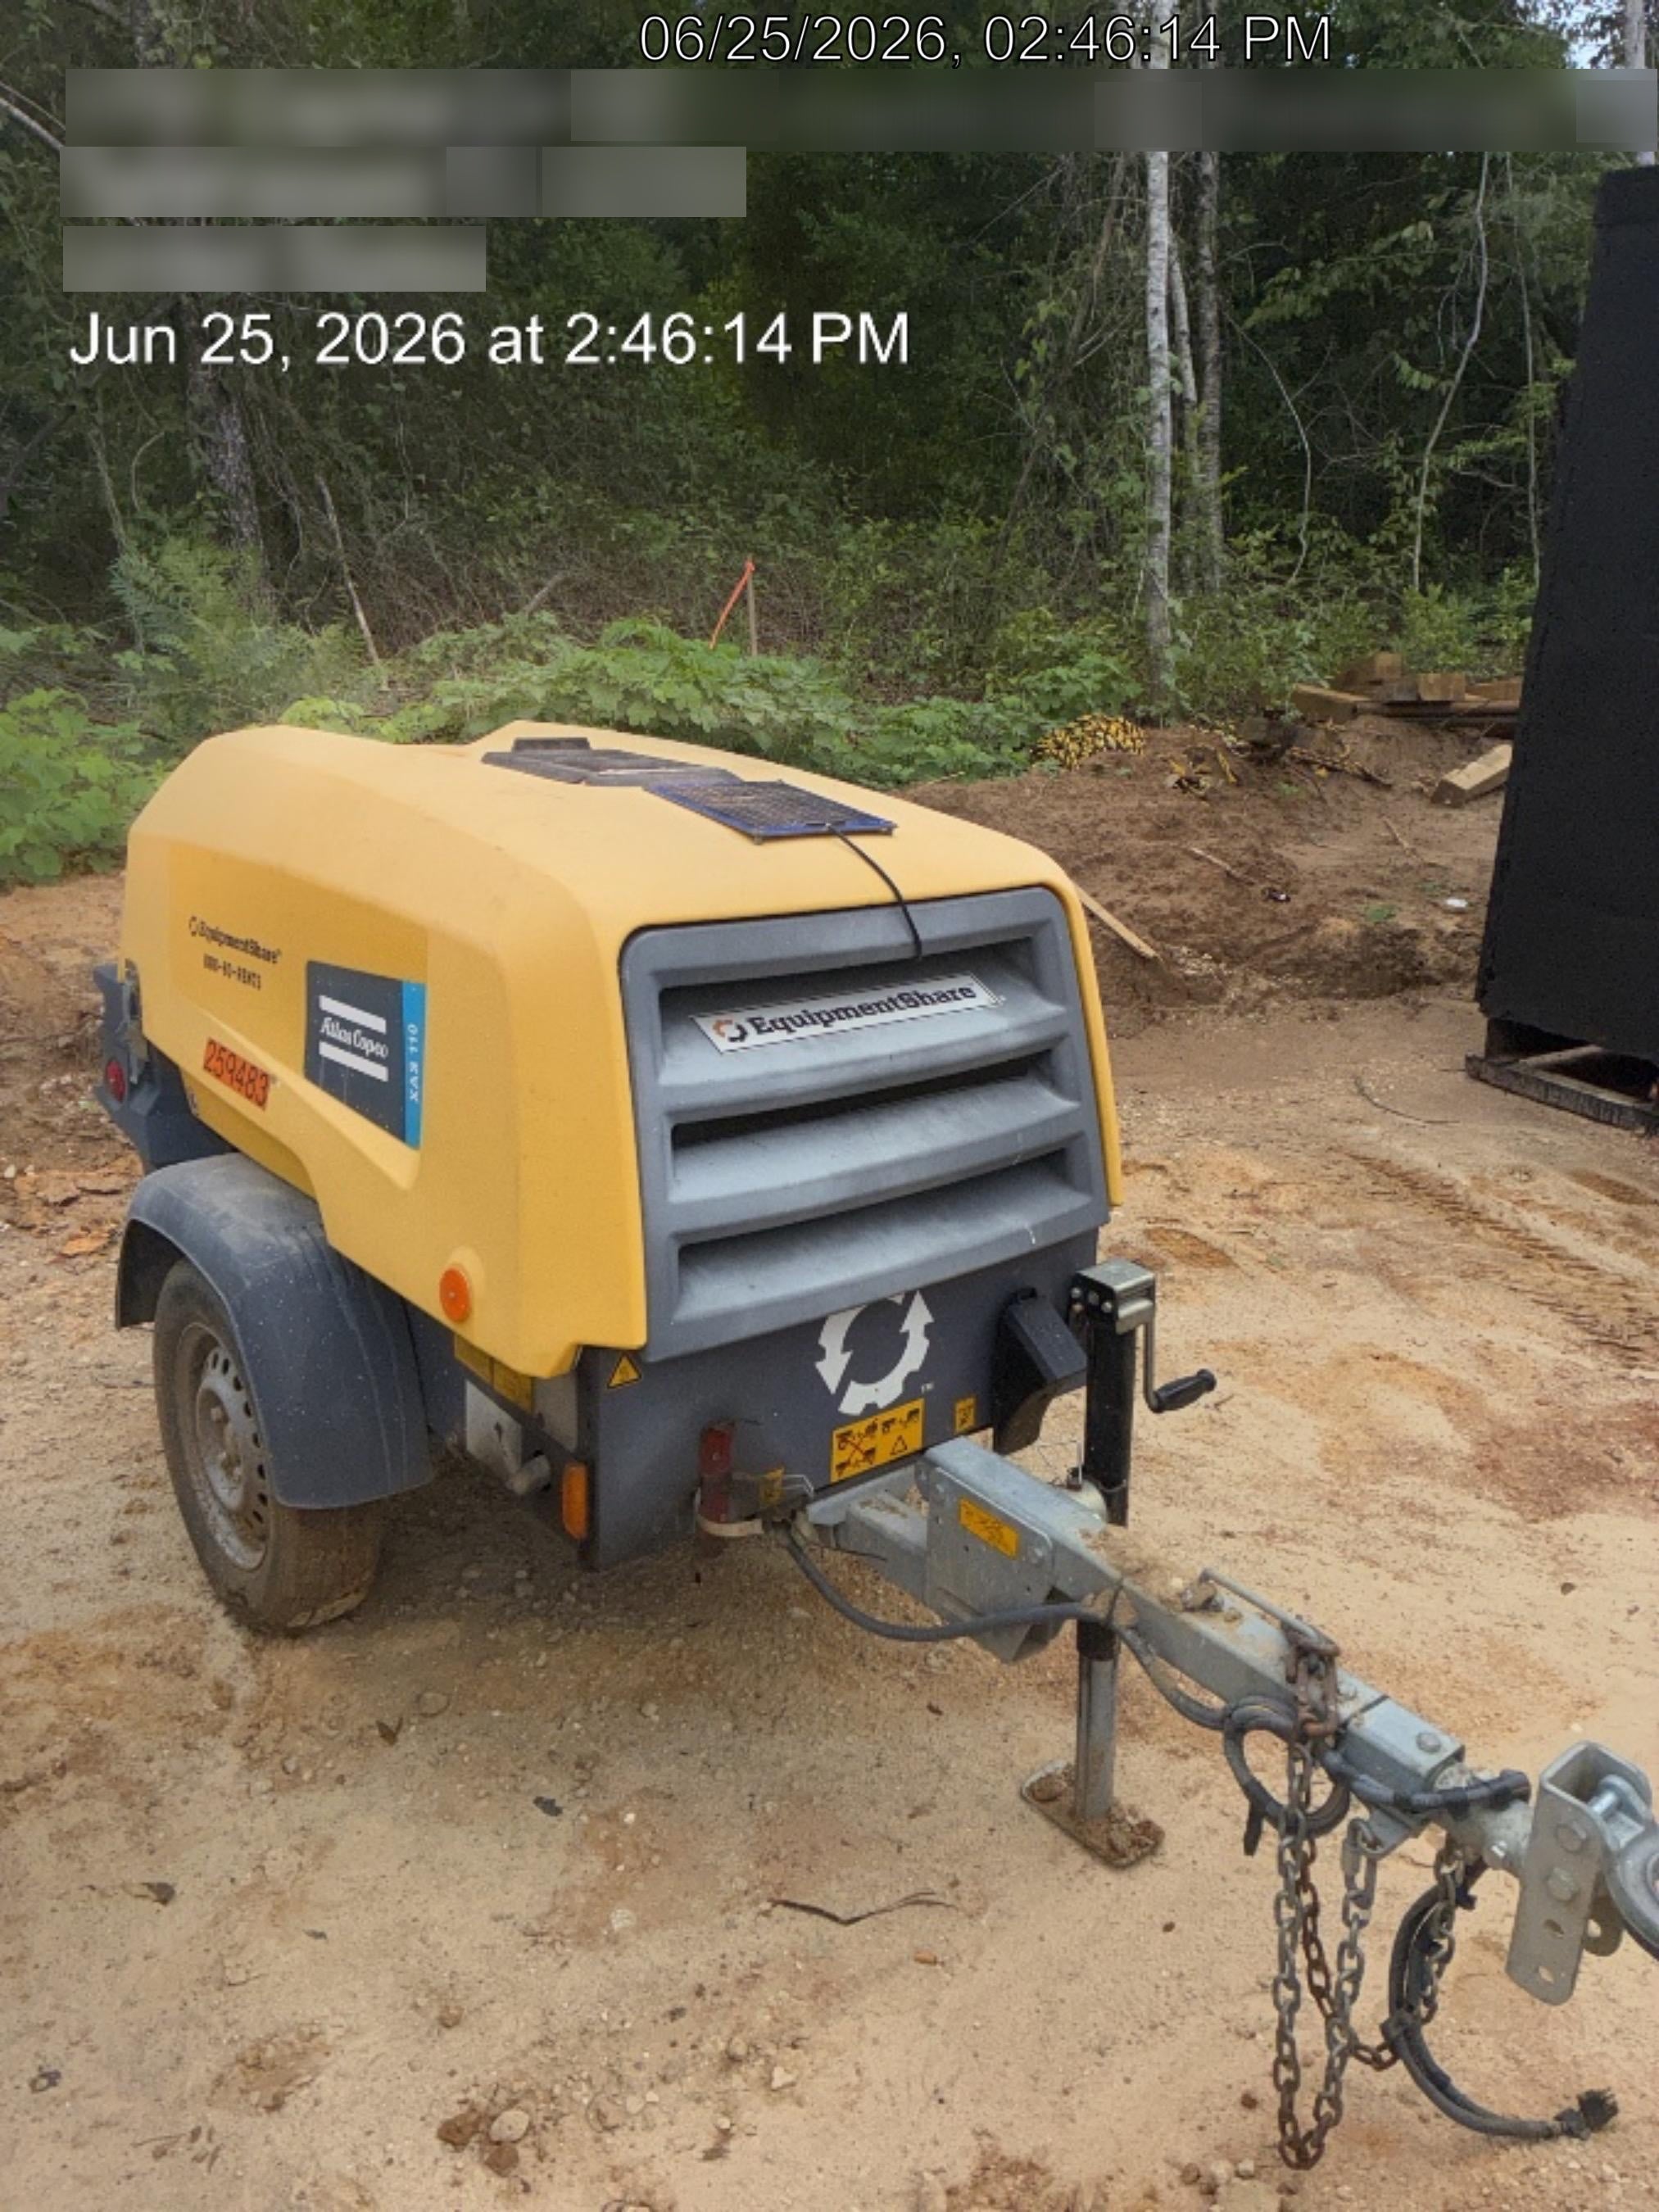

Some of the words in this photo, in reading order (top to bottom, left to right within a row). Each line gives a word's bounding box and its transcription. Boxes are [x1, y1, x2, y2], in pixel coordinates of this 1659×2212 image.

[747, 986, 977, 1034] EquipmentShare
[319, 1017, 352, 1046] Atlas
[352, 1028, 389, 1060] Copco
[406, 1024, 420, 1054] 110
[203, 1039, 270, 1108] 259483
